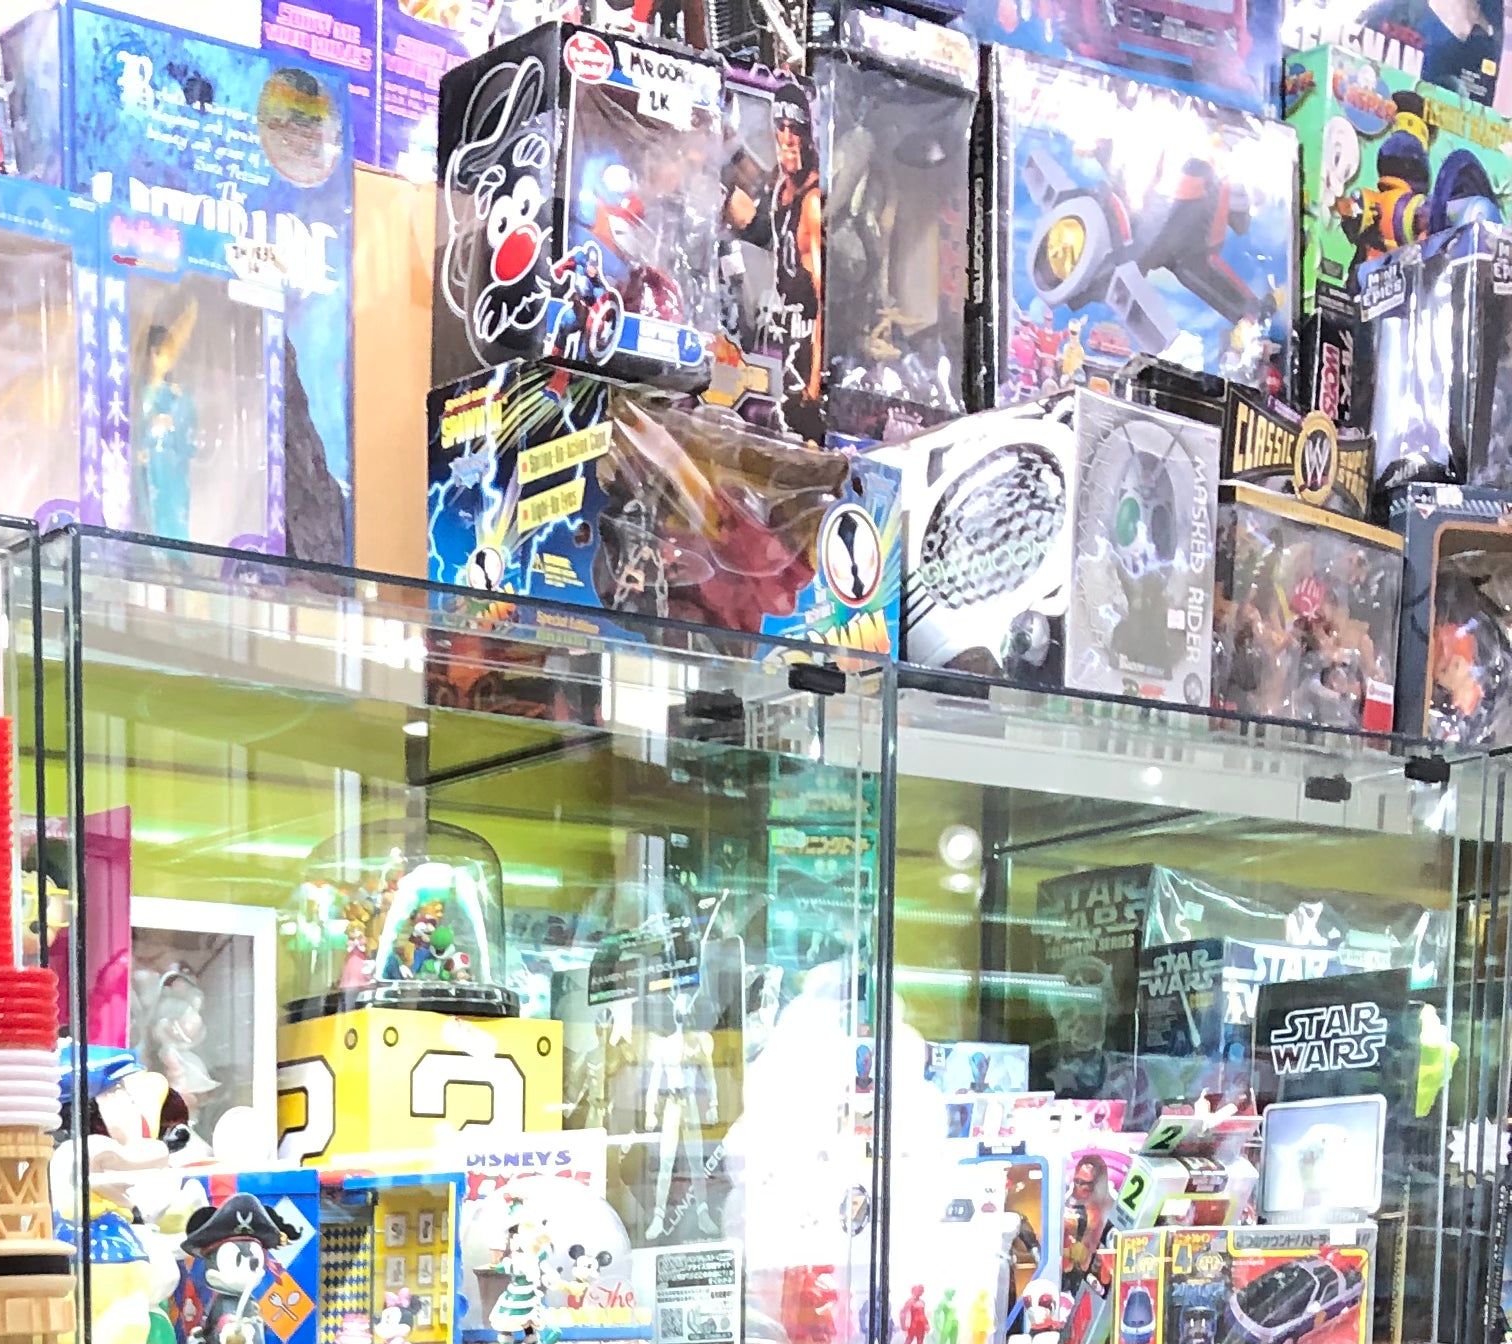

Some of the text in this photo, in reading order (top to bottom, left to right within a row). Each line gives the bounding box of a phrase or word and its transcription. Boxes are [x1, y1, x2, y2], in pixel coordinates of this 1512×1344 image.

[1186, 455, 1208, 663] MASKED RIDER
[1152, 949, 1225, 979] STAR
[1138, 968, 1214, 998] WARS
[1271, 1002, 1388, 1043] STAR
[1271, 1032, 1387, 1076] WARS
[1151, 1124, 1184, 1150] 2
[1122, 1174, 1145, 1211] 2
[597, 1281, 637, 1309] The
